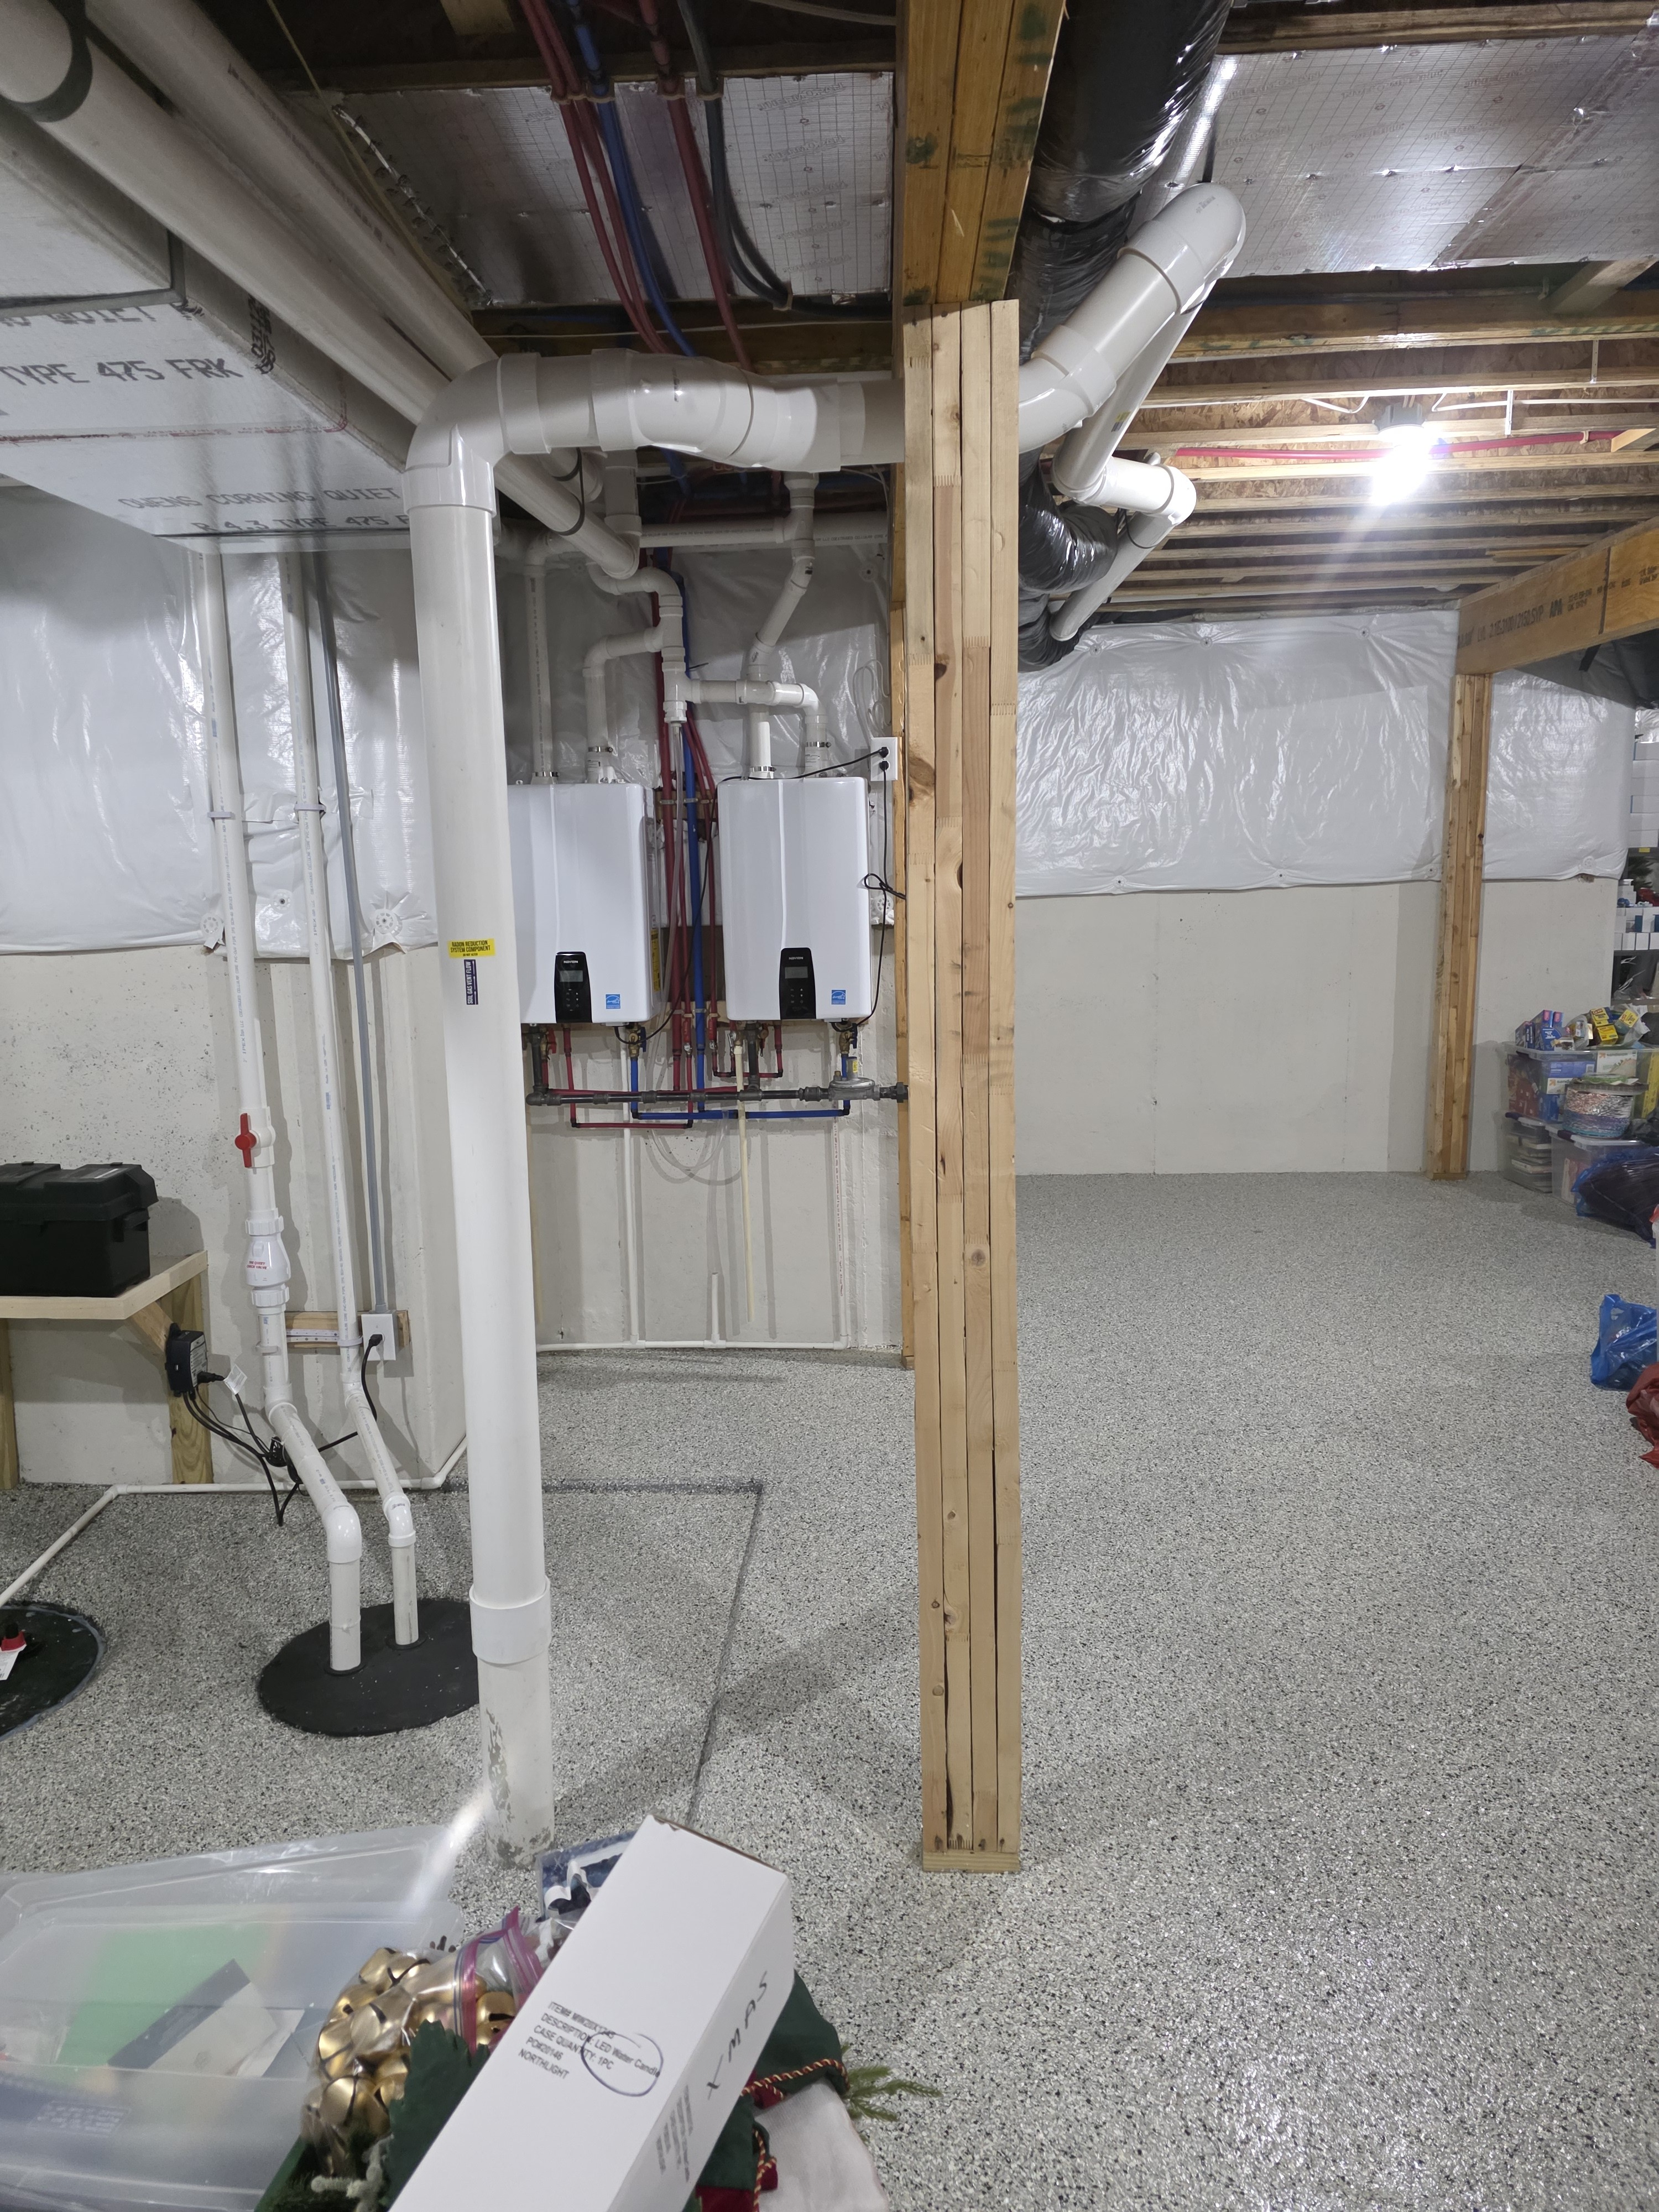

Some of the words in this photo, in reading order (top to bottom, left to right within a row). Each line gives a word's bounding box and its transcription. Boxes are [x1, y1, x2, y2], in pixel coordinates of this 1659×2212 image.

[0, 363, 90, 385] TYPE
[97, 359, 165, 381] 475
[165, 357, 243, 379] FRK
[117, 495, 203, 509] OWENS
[205, 490, 316, 505] CORNING
[323, 487, 401, 501] QUIET
[273, 517, 337, 529] TYPE
[345, 515, 387, 526] 475
[534, 2025, 556, 2041] CASE
[555, 2035, 598, 2062] QUANTITY:
[598, 2056, 614, 2070] 1PC
[594, 2038, 612, 2053] LED
[612, 2048, 634, 2064] Water
[518, 2048, 570, 2079] NORTHLIGHT
